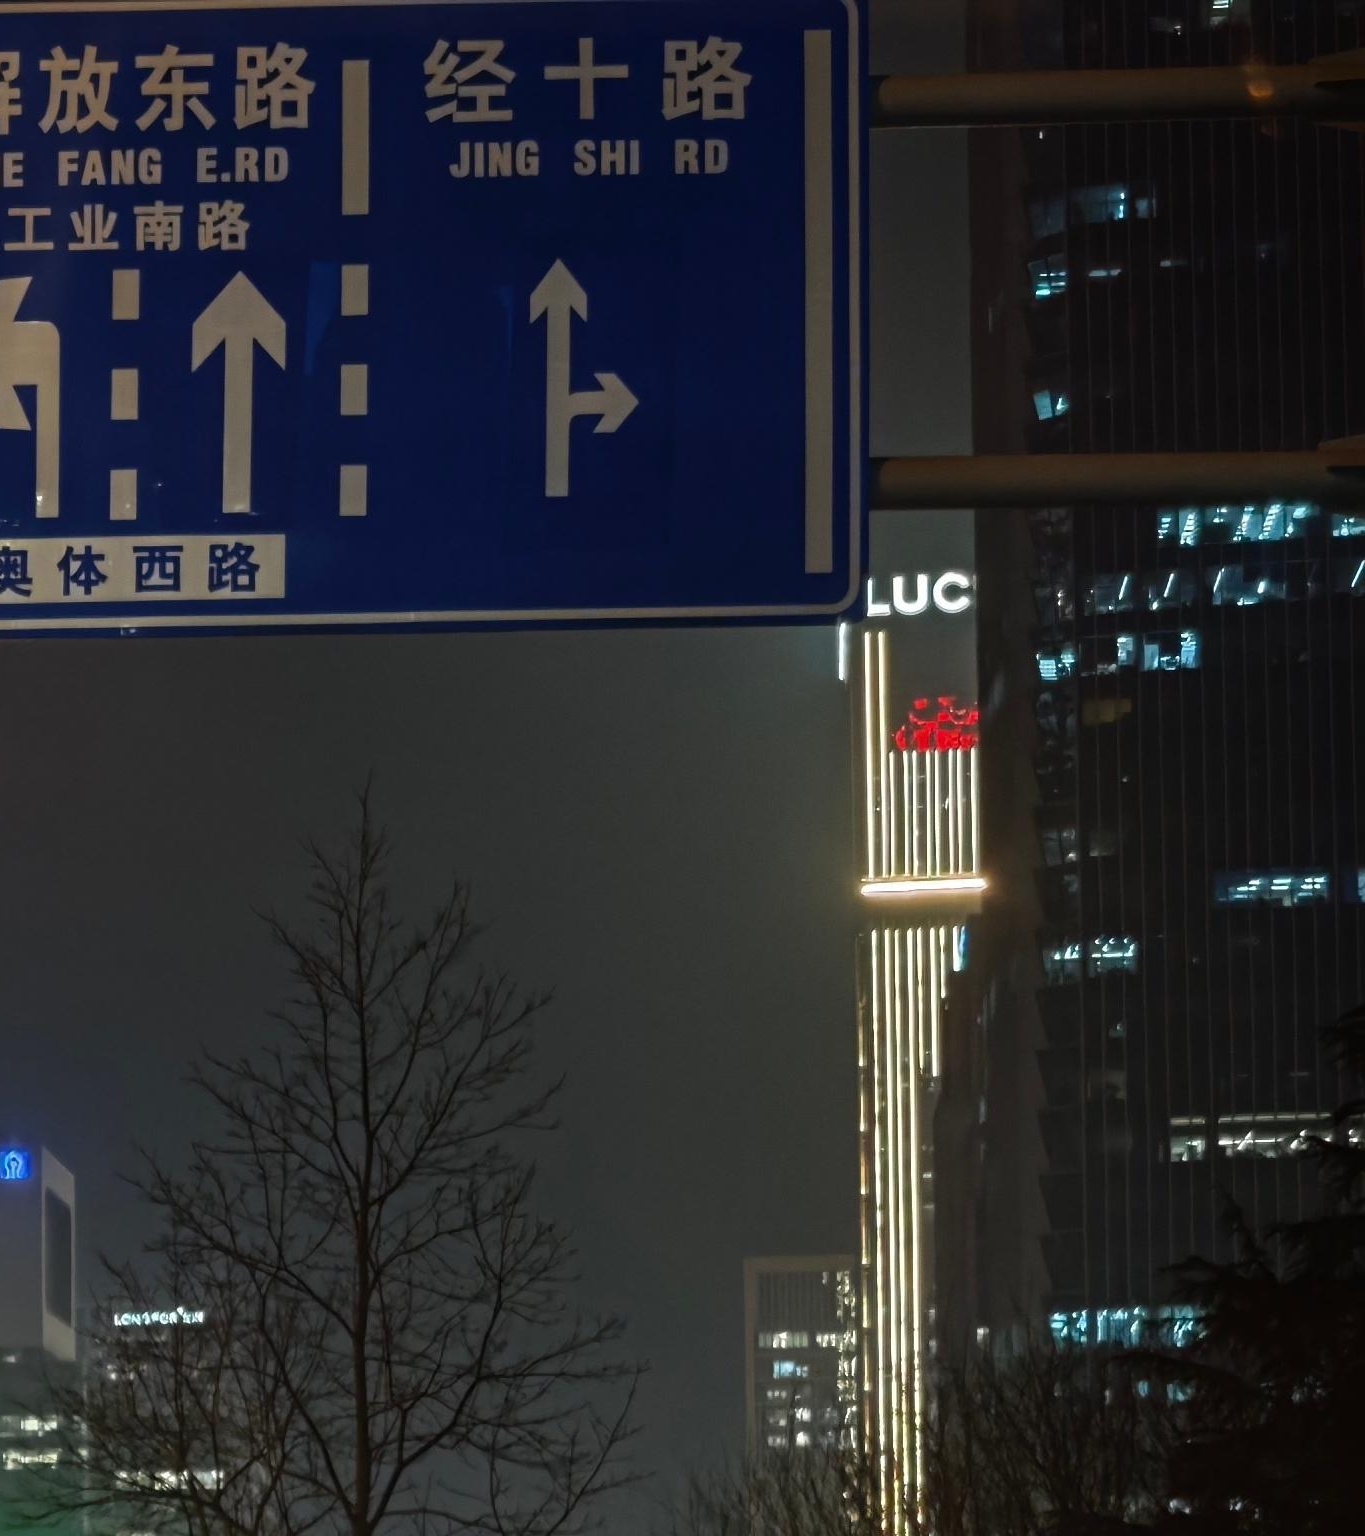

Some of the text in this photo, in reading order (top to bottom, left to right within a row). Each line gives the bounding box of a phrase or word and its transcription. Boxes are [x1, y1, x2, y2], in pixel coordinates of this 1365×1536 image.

[424, 36, 752, 123] 经十路
[58, 148, 162, 187] FANG
[196, 146, 289, 183] E.RD
[450, 139, 728, 178] JING SHI RD
[3, 199, 250, 252] 工业南路
